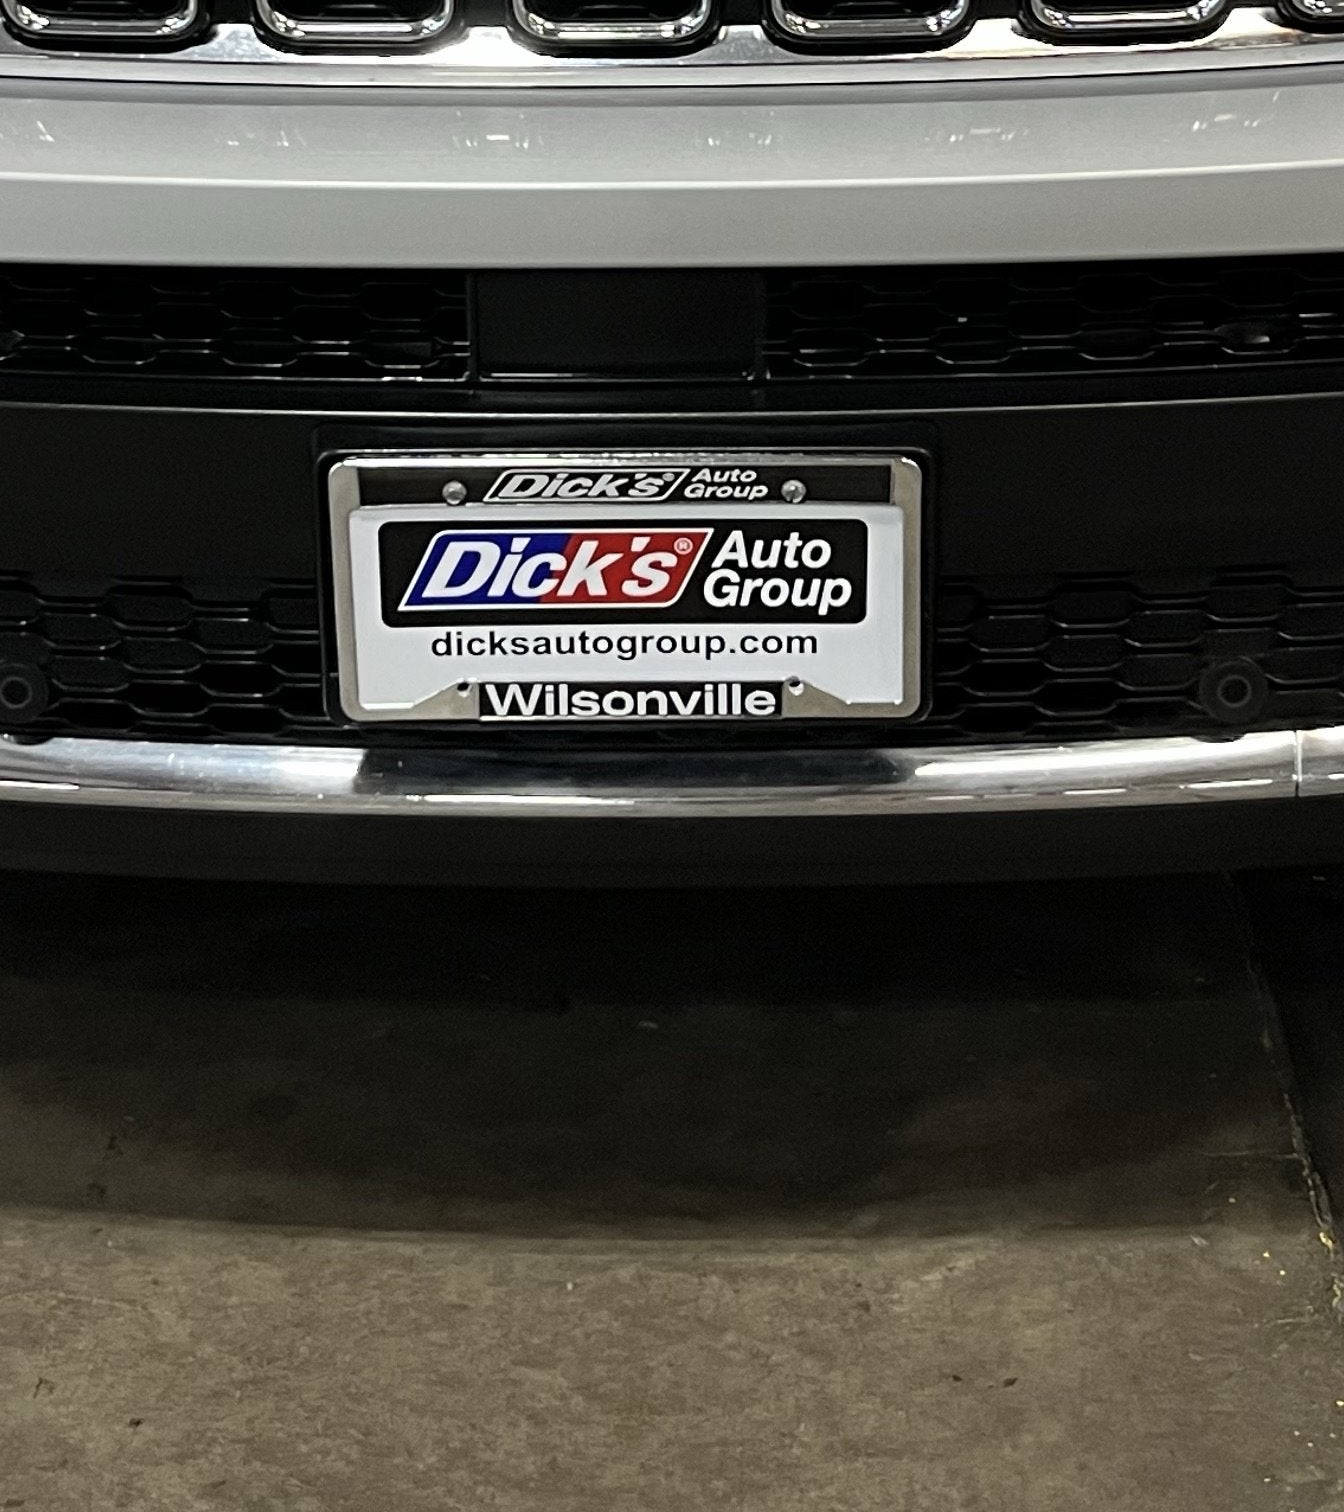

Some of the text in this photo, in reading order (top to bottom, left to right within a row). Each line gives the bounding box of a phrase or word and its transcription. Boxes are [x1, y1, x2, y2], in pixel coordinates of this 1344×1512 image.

[692, 469, 757, 483] Auto
[684, 484, 768, 500] Group
[711, 530, 831, 568] Auto
[703, 568, 852, 616] Group
[431, 631, 818, 660] dicksautogroup.com
[486, 684, 776, 717] Wilsonville
